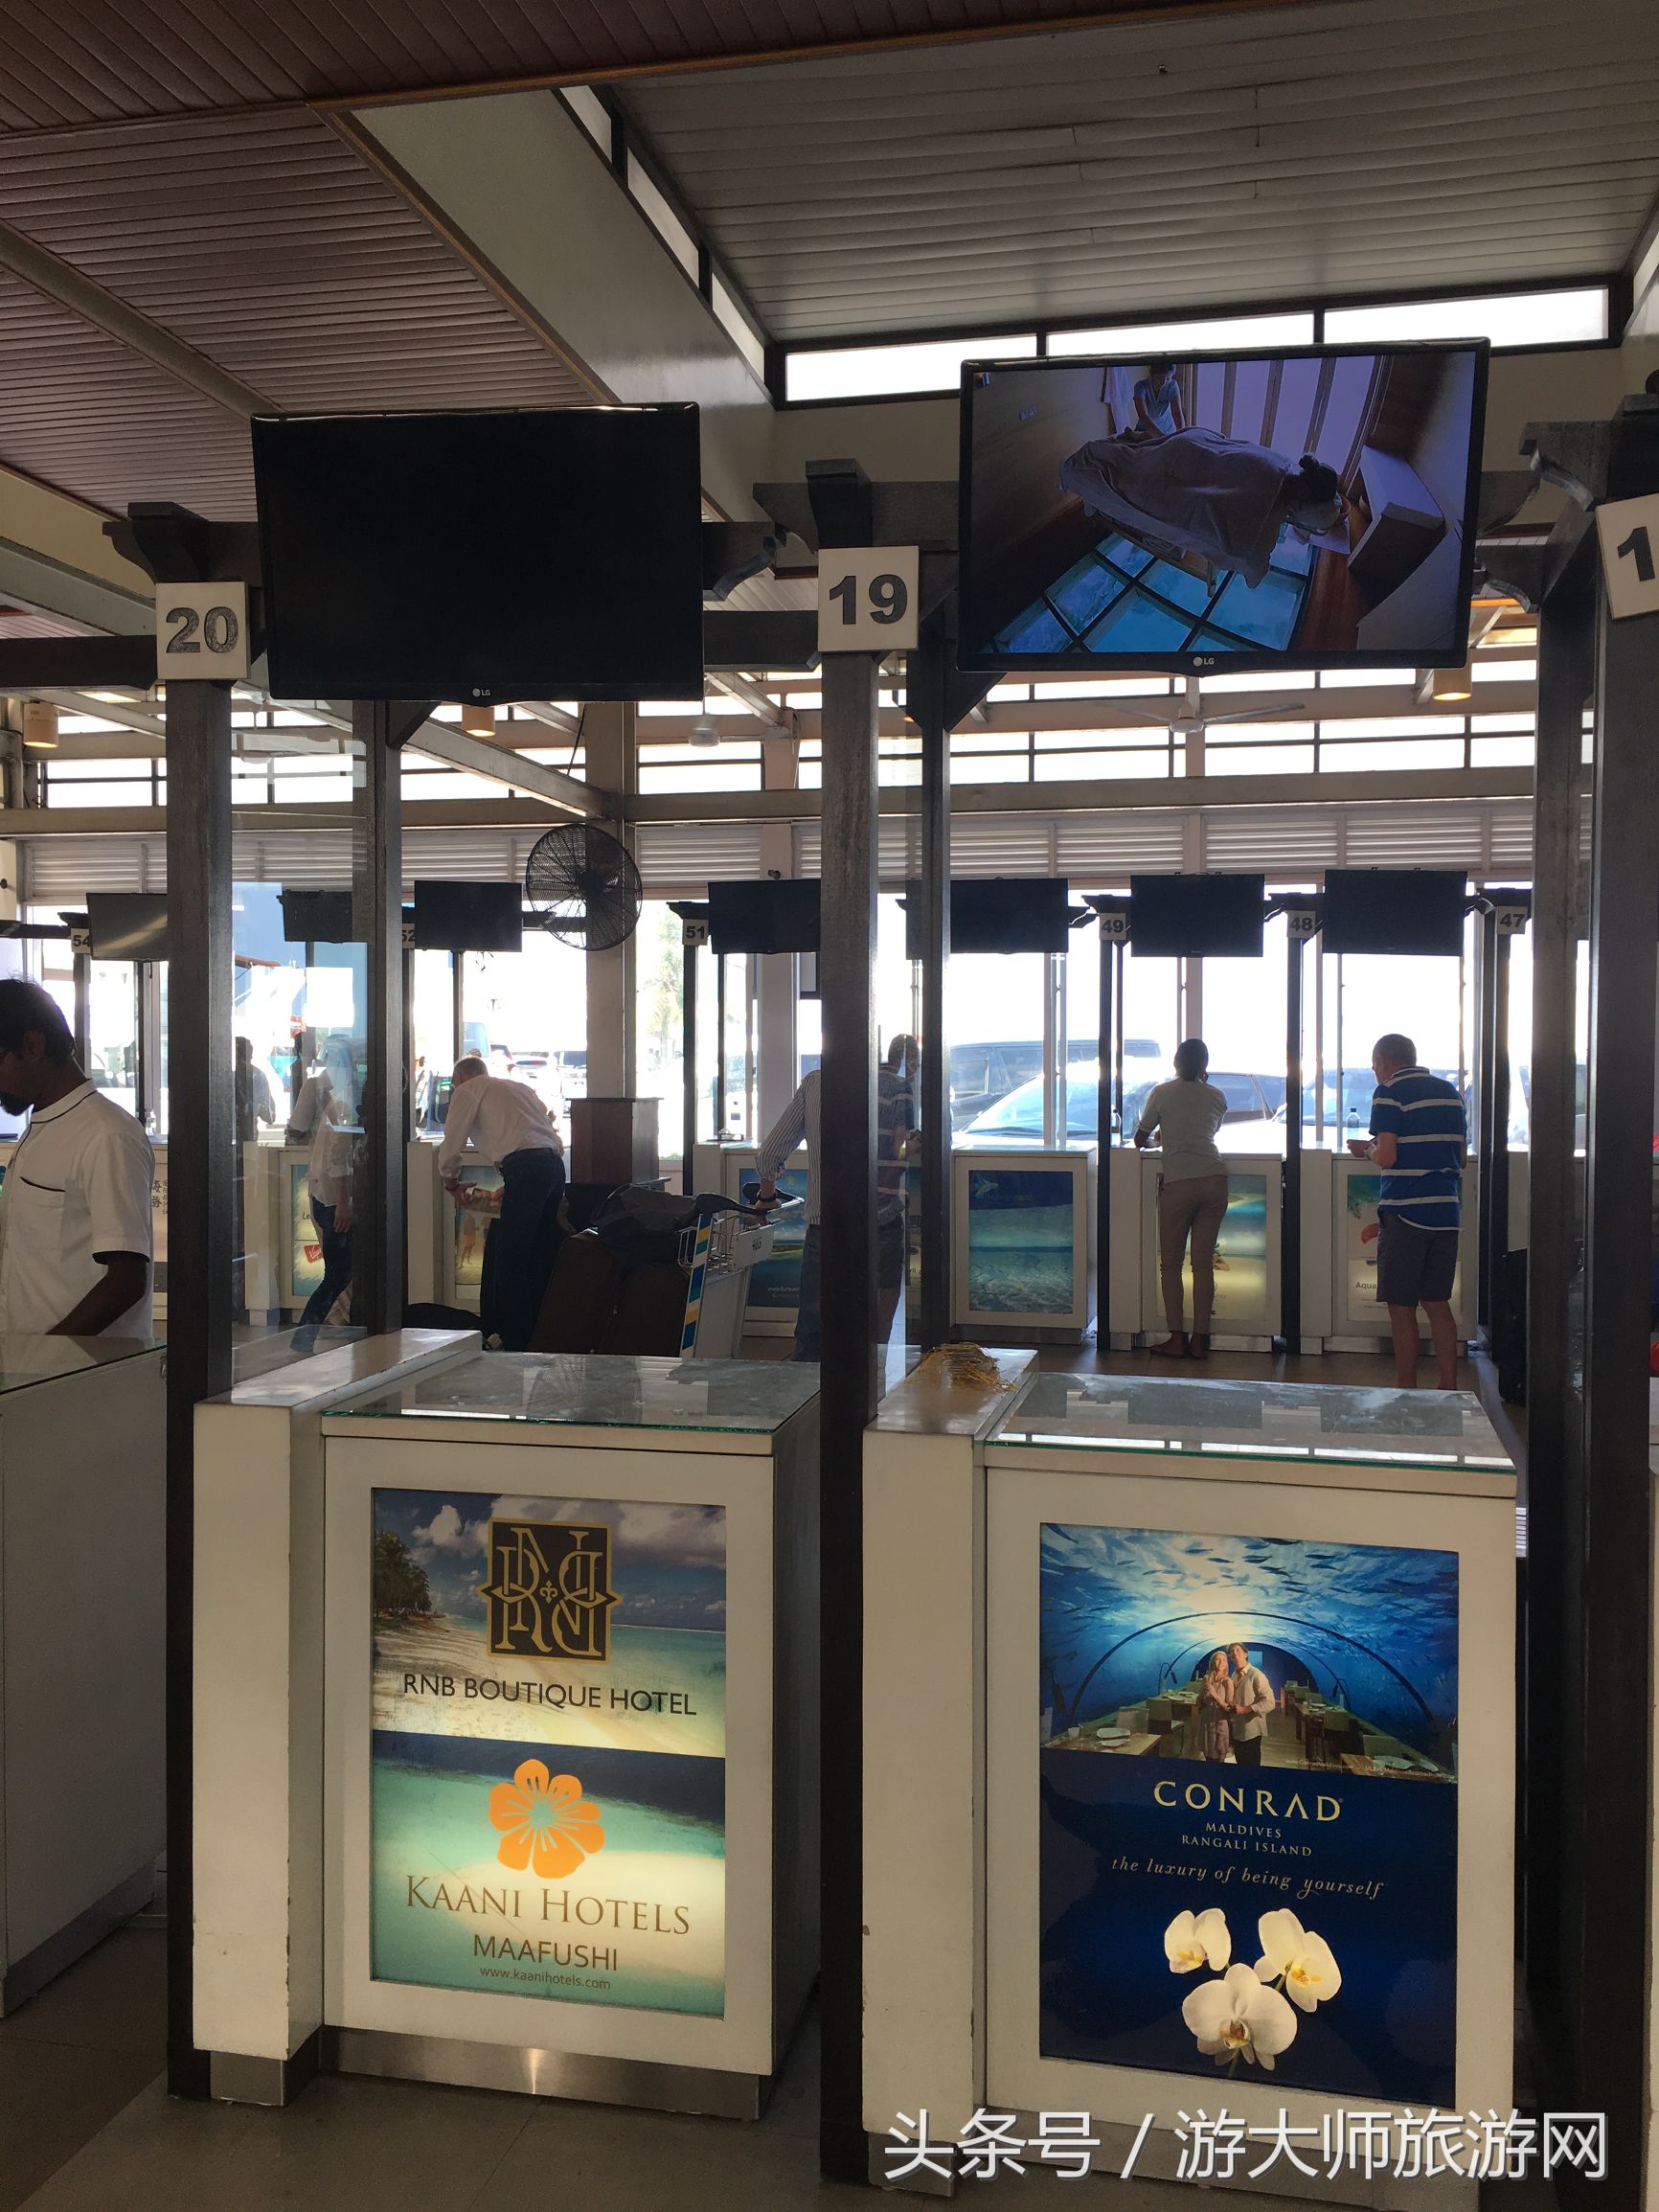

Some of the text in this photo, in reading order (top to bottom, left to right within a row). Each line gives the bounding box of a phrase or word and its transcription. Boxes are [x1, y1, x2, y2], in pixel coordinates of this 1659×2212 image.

[828, 573, 909, 626] 19
[165, 605, 239, 654] 20
[1203, 657, 1215, 666] LG
[686, 925, 705, 939] 51
[1102, 919, 1125, 933] 49
[1289, 917, 1313, 931] 48
[1500, 913, 1526, 928] 47
[403, 1674, 697, 1716] RNB BOUTIQUE HOTEL
[1153, 1780, 1341, 1822] CONRAD
[1205, 1822, 1283, 1838] MALDIVES
[1181, 1835, 1312, 1857] RANGALI ISLAND
[1111, 1858, 1385, 1900] the luxury of being yourself
[405, 1875, 690, 1935] KAANI HOTELS
[473, 1934, 618, 1972] MAAFUSHI
[480, 1967, 611, 1990] www.kaanihotels.com
